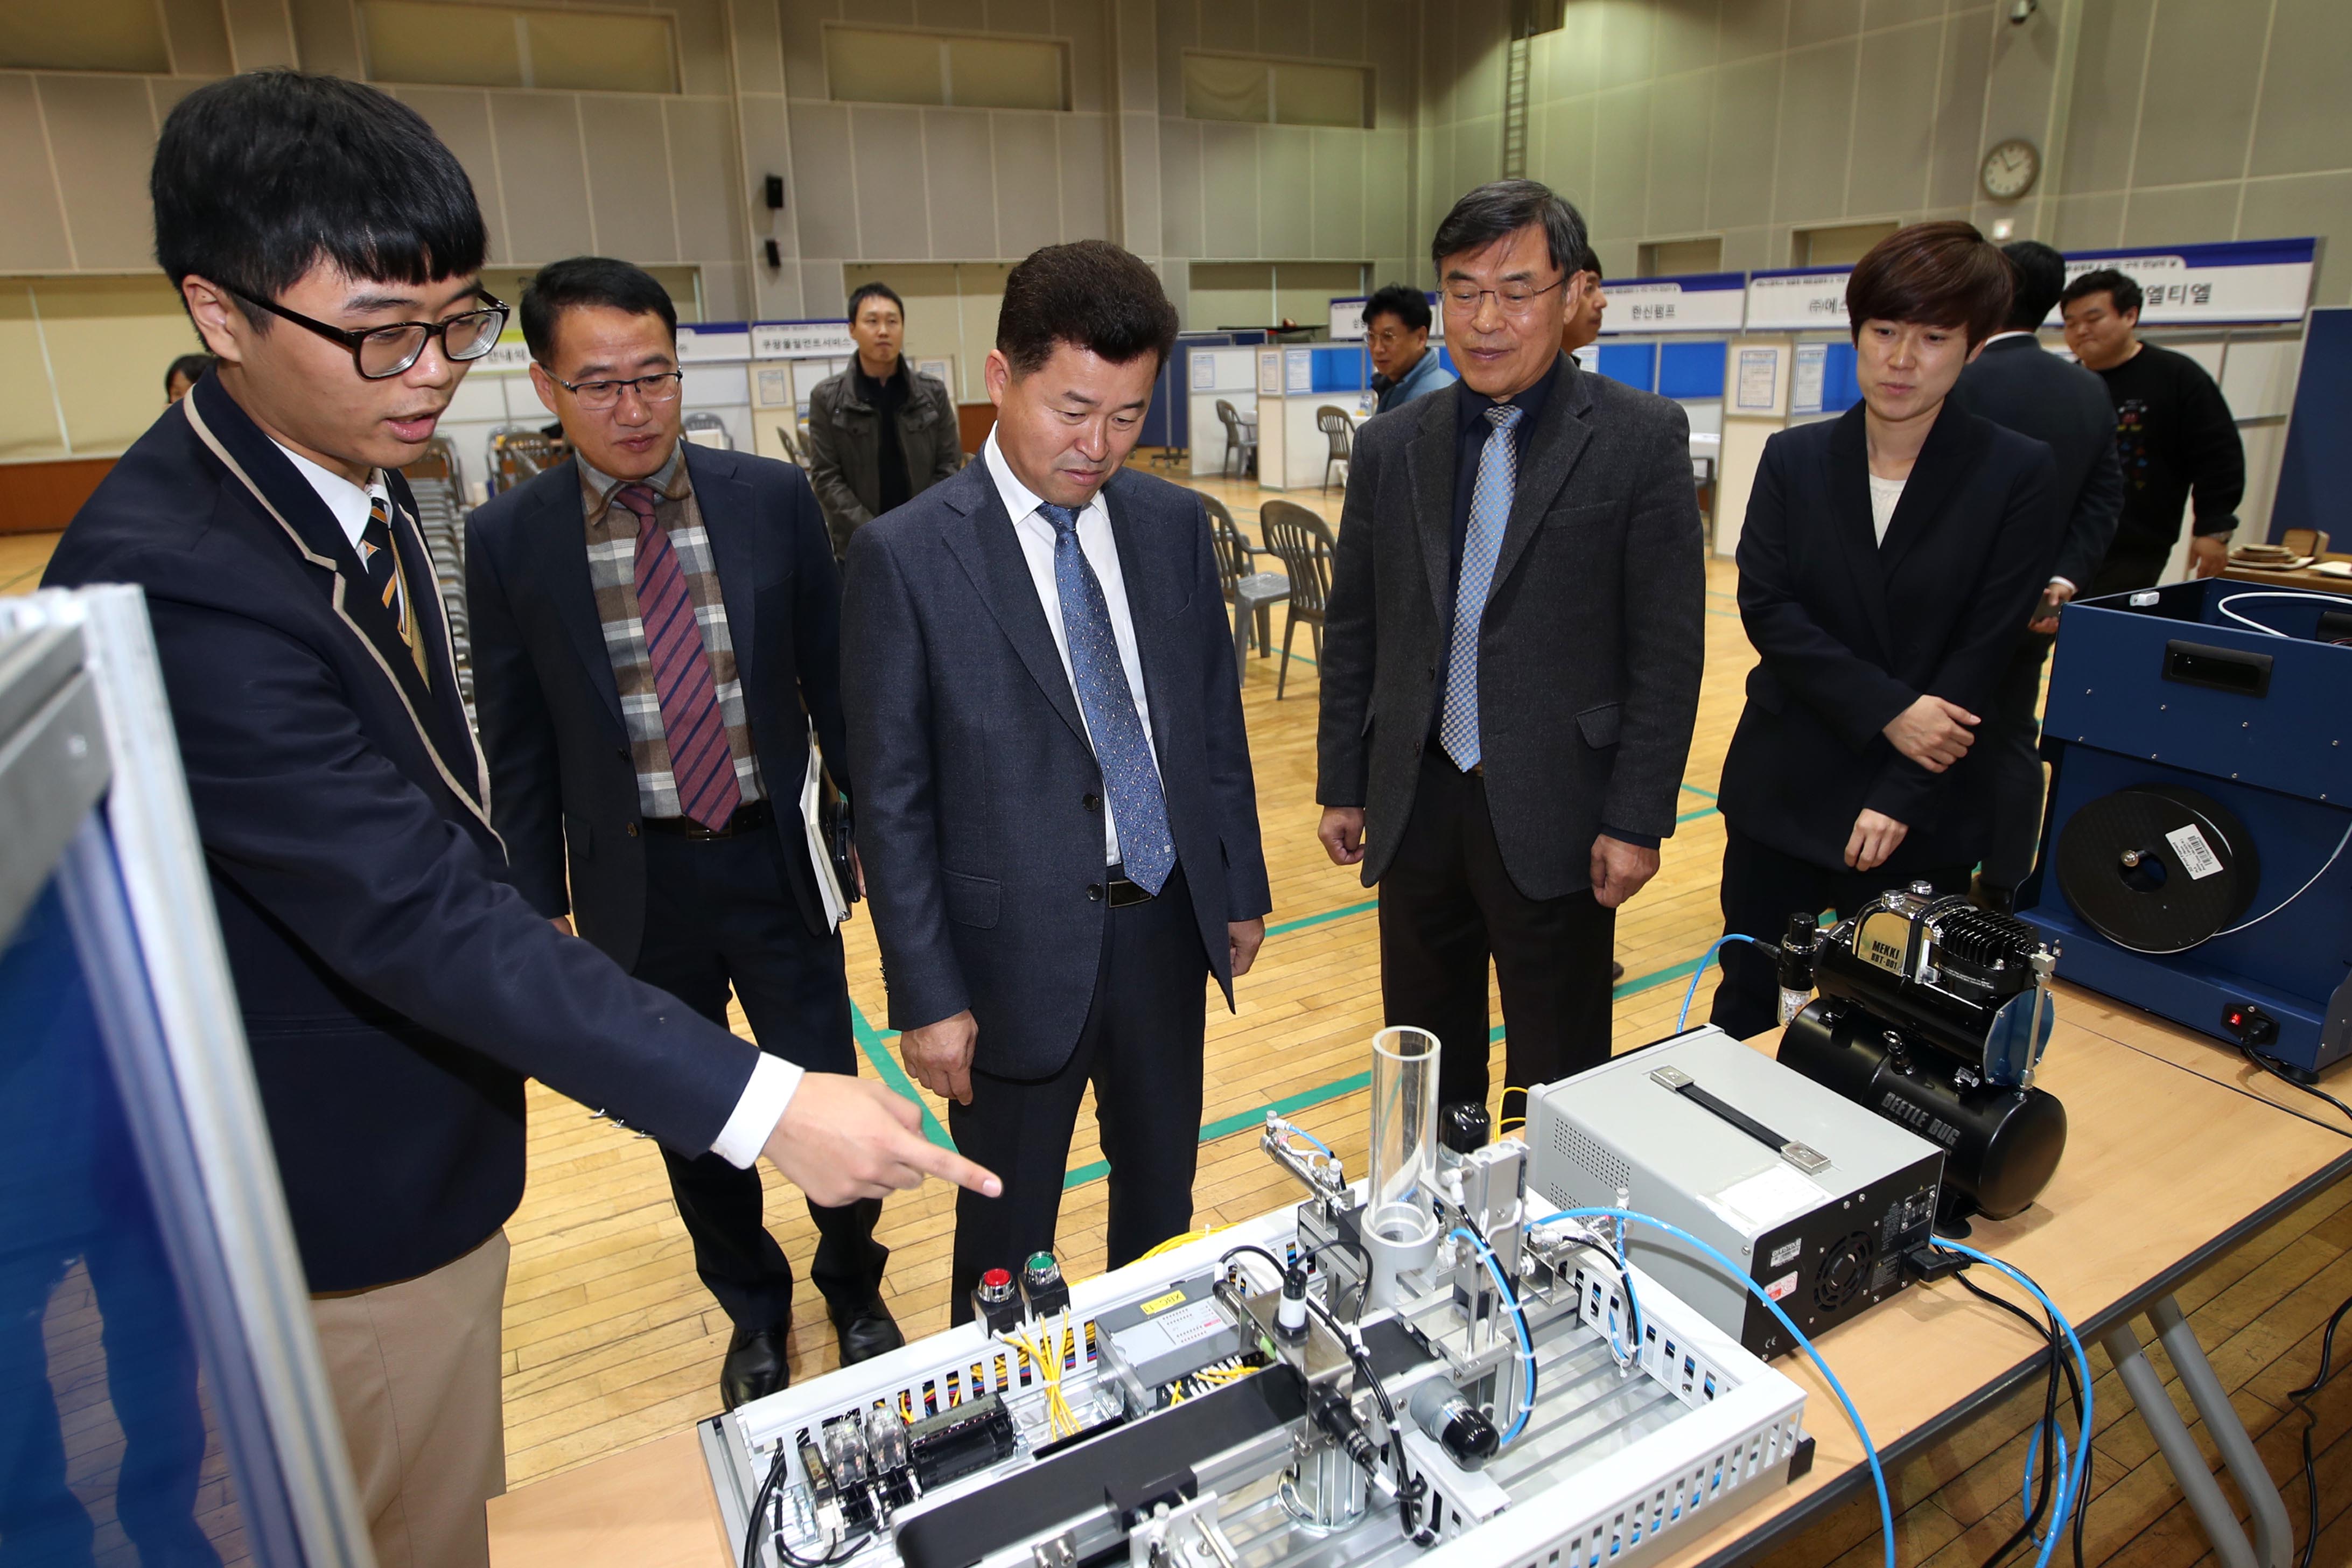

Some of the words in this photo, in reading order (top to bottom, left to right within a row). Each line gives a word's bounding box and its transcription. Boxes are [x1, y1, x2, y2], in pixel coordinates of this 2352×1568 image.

[2146, 283, 2211, 304] 엘티엘
[1632, 304, 1675, 319] 한신펌프
[1872, 941, 1900, 960] MEKKI
[1871, 953, 1898, 970] BBT-001
[1881, 1091, 1929, 1128] BEETLE
[1928, 1118, 1961, 1146] BUG
